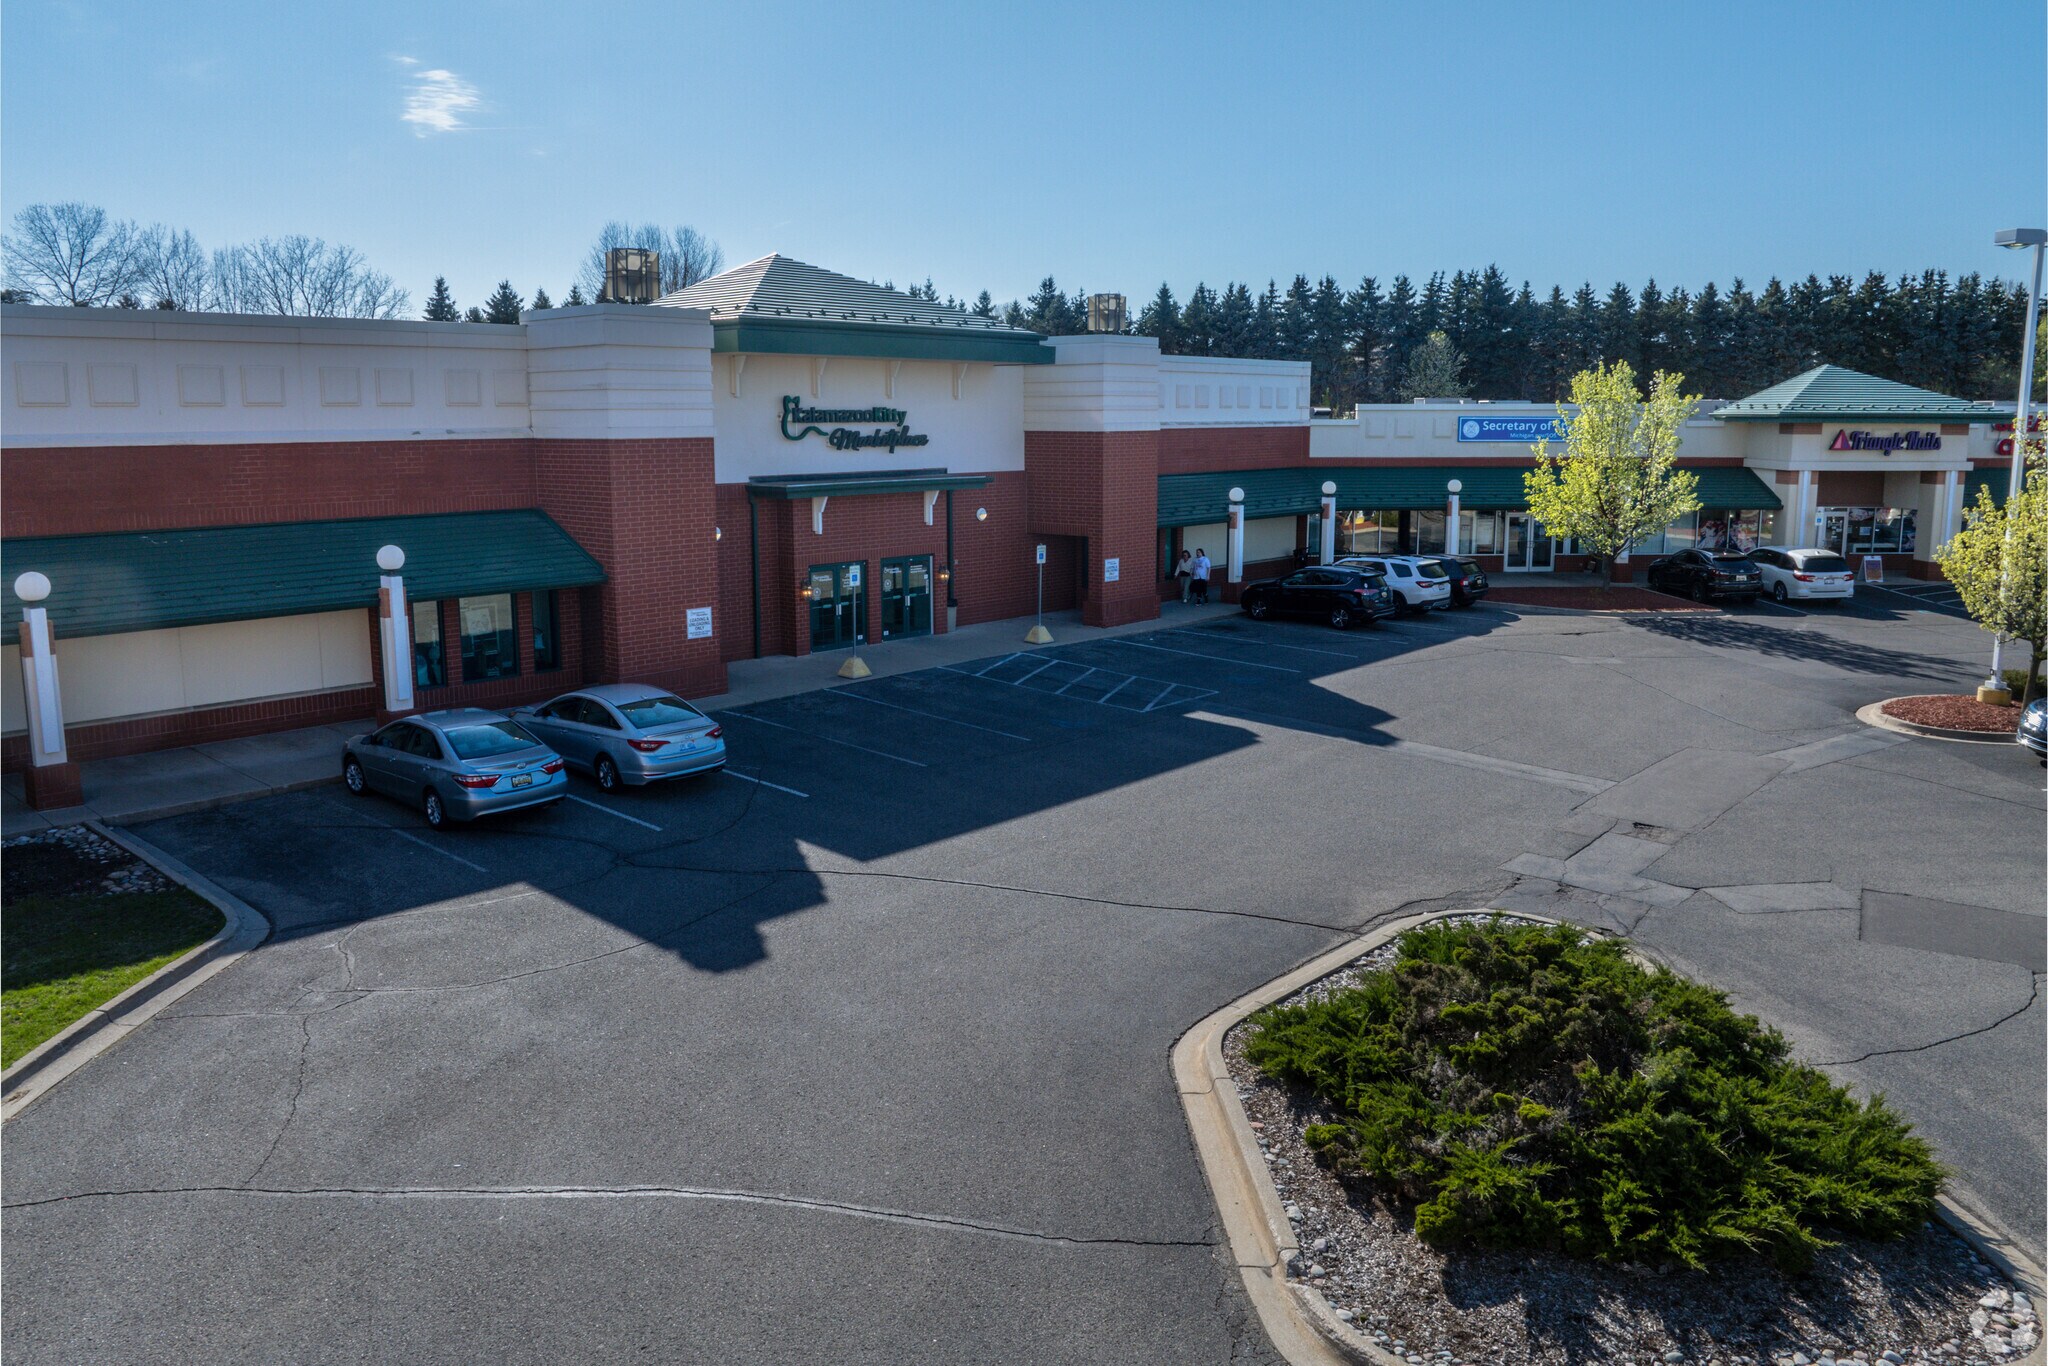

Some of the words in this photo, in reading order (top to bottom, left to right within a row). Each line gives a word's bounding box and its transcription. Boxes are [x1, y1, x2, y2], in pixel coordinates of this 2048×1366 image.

[1482, 420, 1537, 433] Secretary
[1540, 420, 1553, 431] of
[829, 425, 929, 454] Marketplace
[1850, 431, 1905, 456] Triangle
[1904, 431, 1942, 450] Nails
